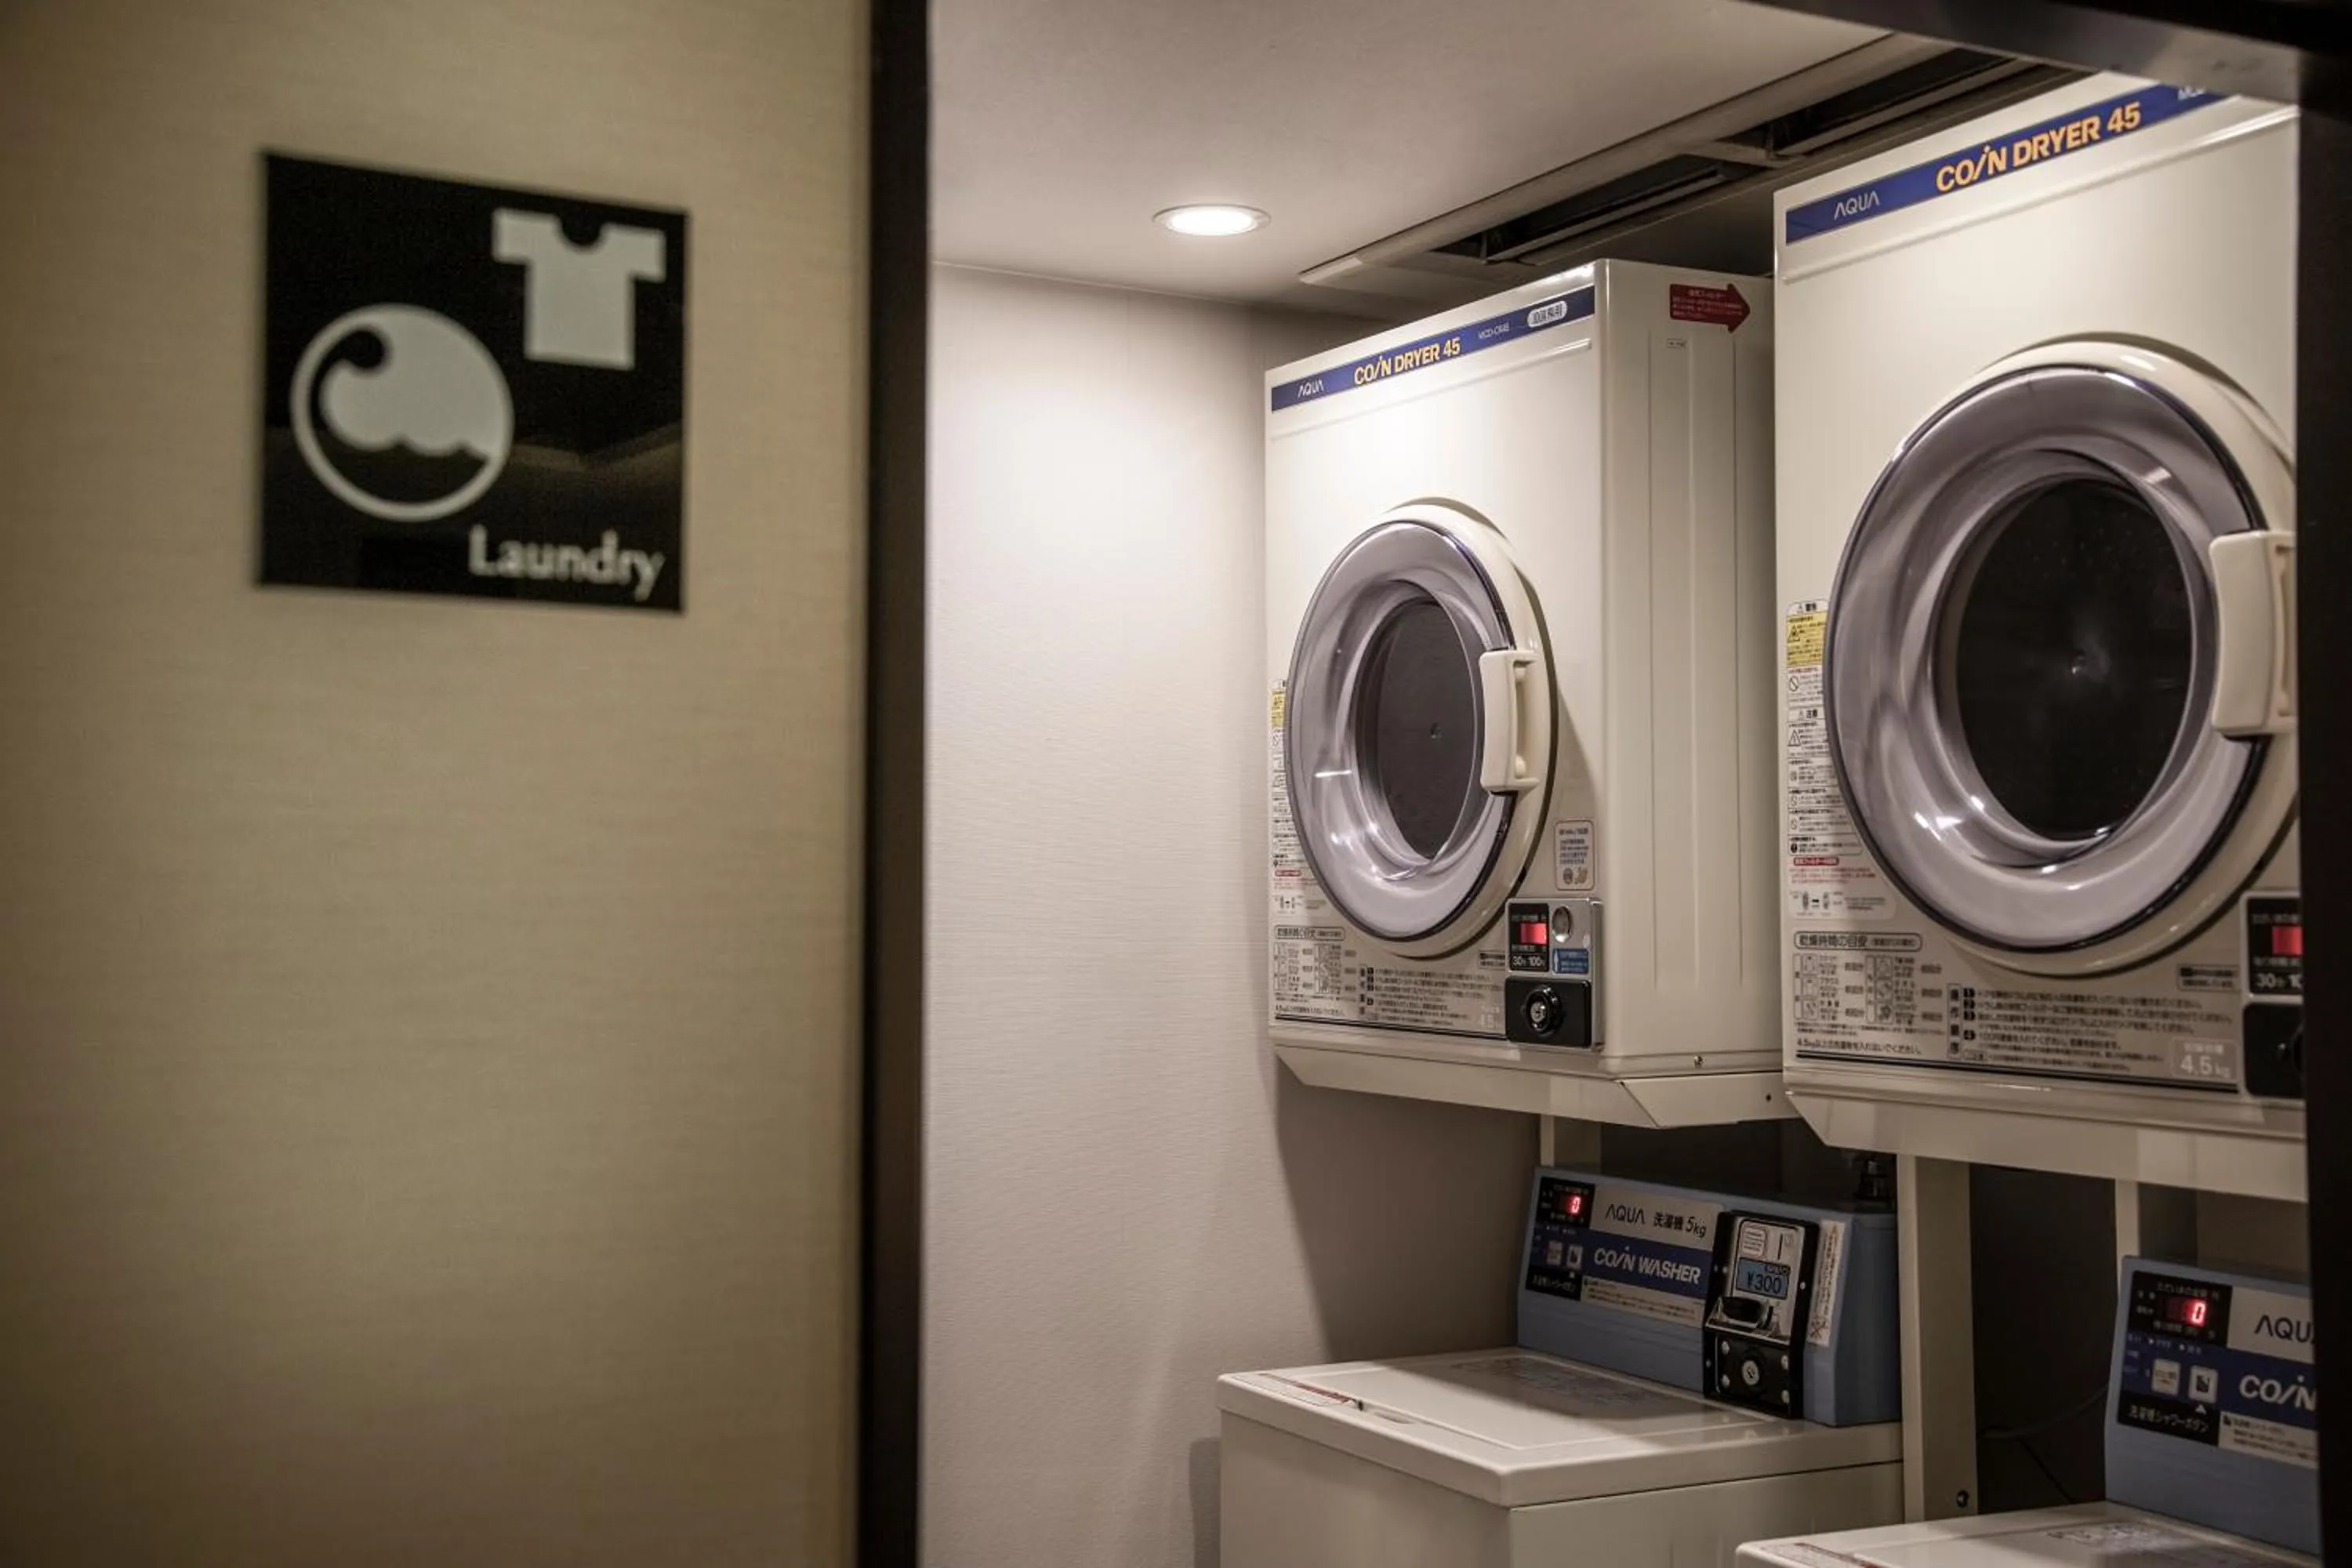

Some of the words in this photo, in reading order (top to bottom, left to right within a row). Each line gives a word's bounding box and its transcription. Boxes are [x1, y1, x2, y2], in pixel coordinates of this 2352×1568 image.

[1834, 190, 1879, 220] AQUA
[2013, 115, 2100, 165] DRYER
[2107, 102, 2141, 132] 45
[1298, 380, 1324, 397] AQUA
[1395, 343, 1440, 373] DRYER
[1443, 337, 1461, 358] 45
[469, 524, 666, 601] Laundry
[1570, 1196, 1581, 1214] 0
[1605, 1203, 1646, 1225] AQUA
[1653, 1212, 1683, 1230] 洗濯機
[1686, 1217, 1707, 1239] 5kg
[1639, 1256, 1701, 1285] WASHER
[1747, 1271, 1783, 1294] ¥300
[2191, 1301, 2207, 1327] 0
[2254, 1314, 2314, 1344] AQU
